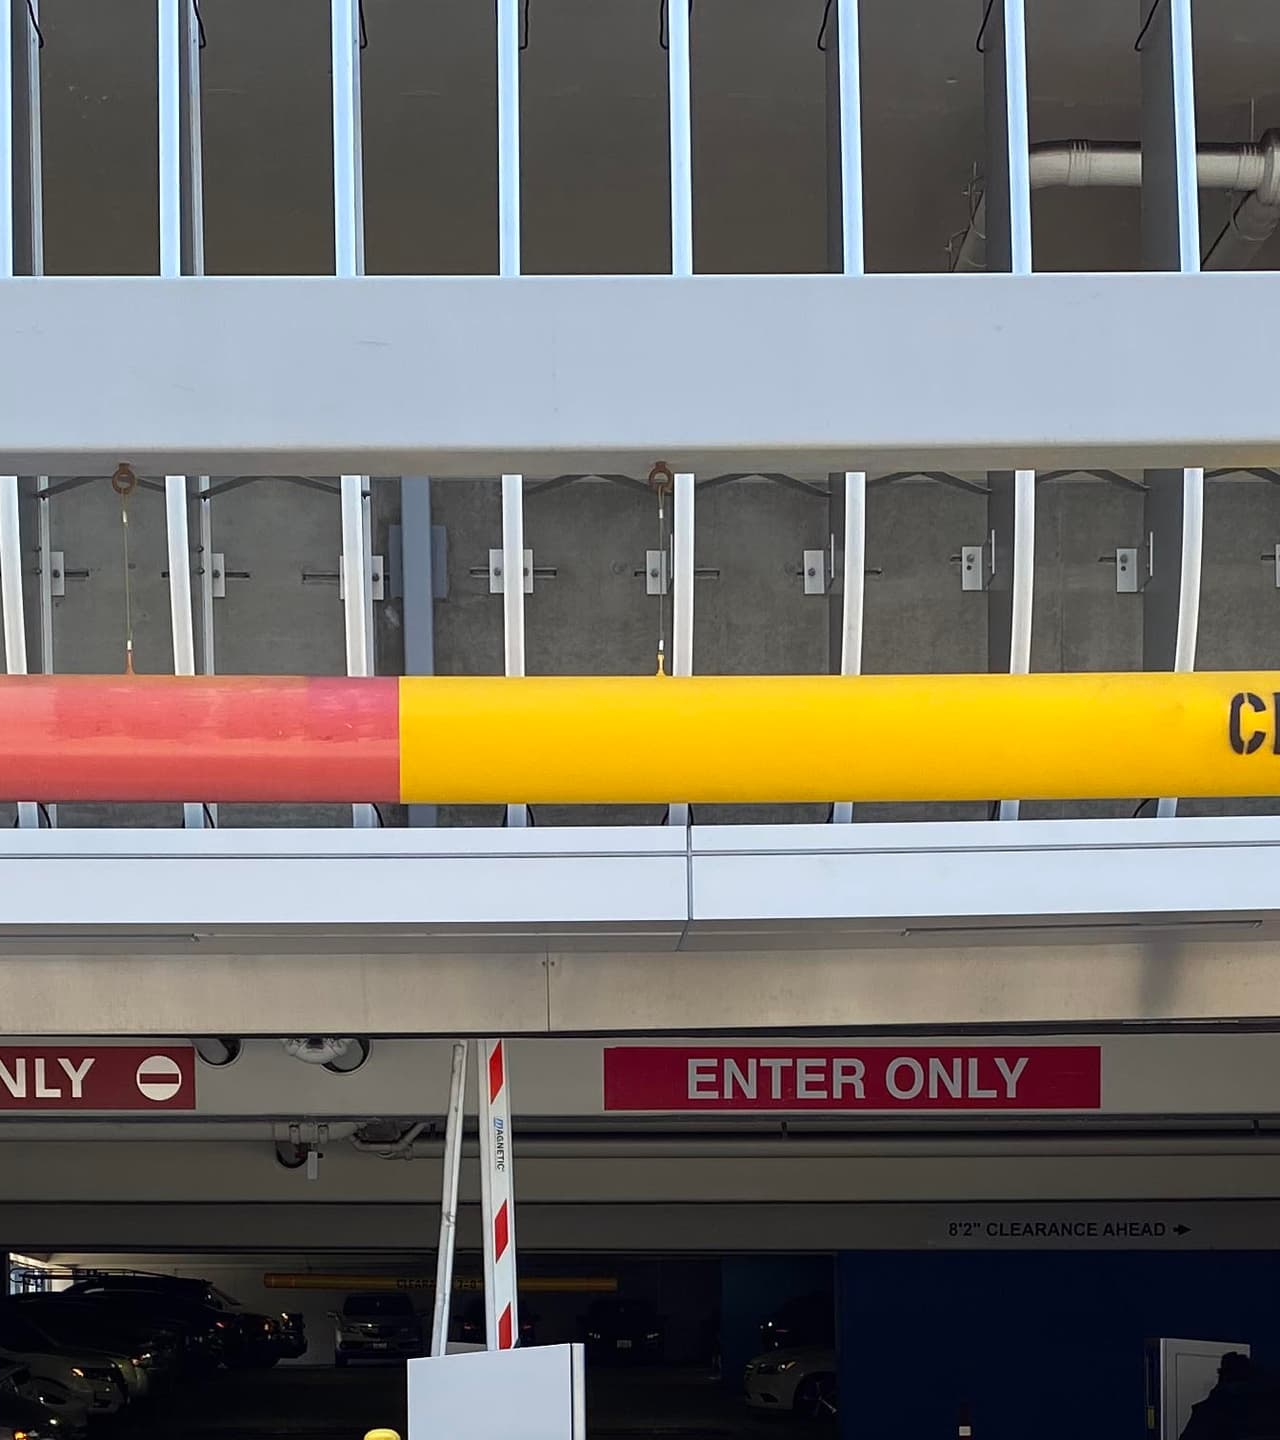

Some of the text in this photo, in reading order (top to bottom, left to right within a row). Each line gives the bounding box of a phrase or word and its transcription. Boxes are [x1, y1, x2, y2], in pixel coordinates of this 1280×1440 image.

[687, 1056, 1030, 1100] ENTER ONLY
[986, 1222, 1098, 1237] CLEARANCE
[1103, 1222, 1166, 1237] AHEAD
